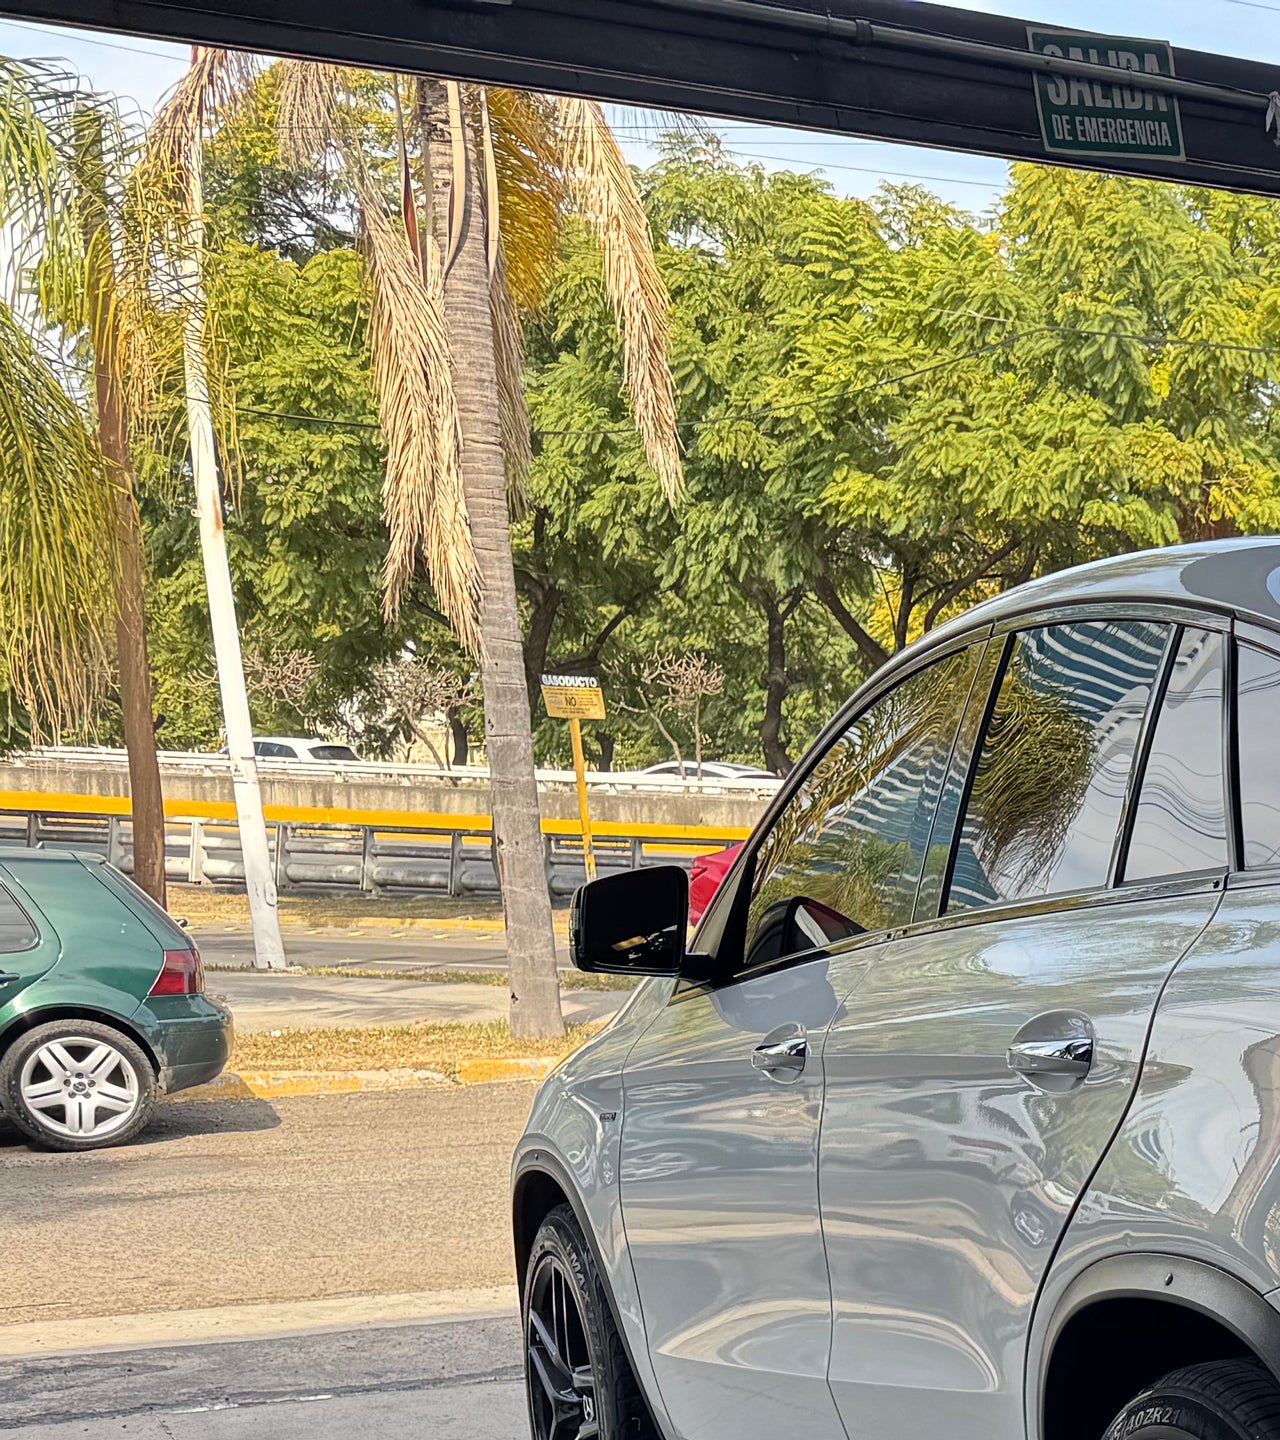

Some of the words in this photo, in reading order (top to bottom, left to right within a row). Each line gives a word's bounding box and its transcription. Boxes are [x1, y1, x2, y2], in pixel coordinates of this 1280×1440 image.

[1051, 114, 1074, 141] DE
[1077, 119, 1172, 147] EMERGENCIA
[542, 675, 597, 688] GASODUCTO
